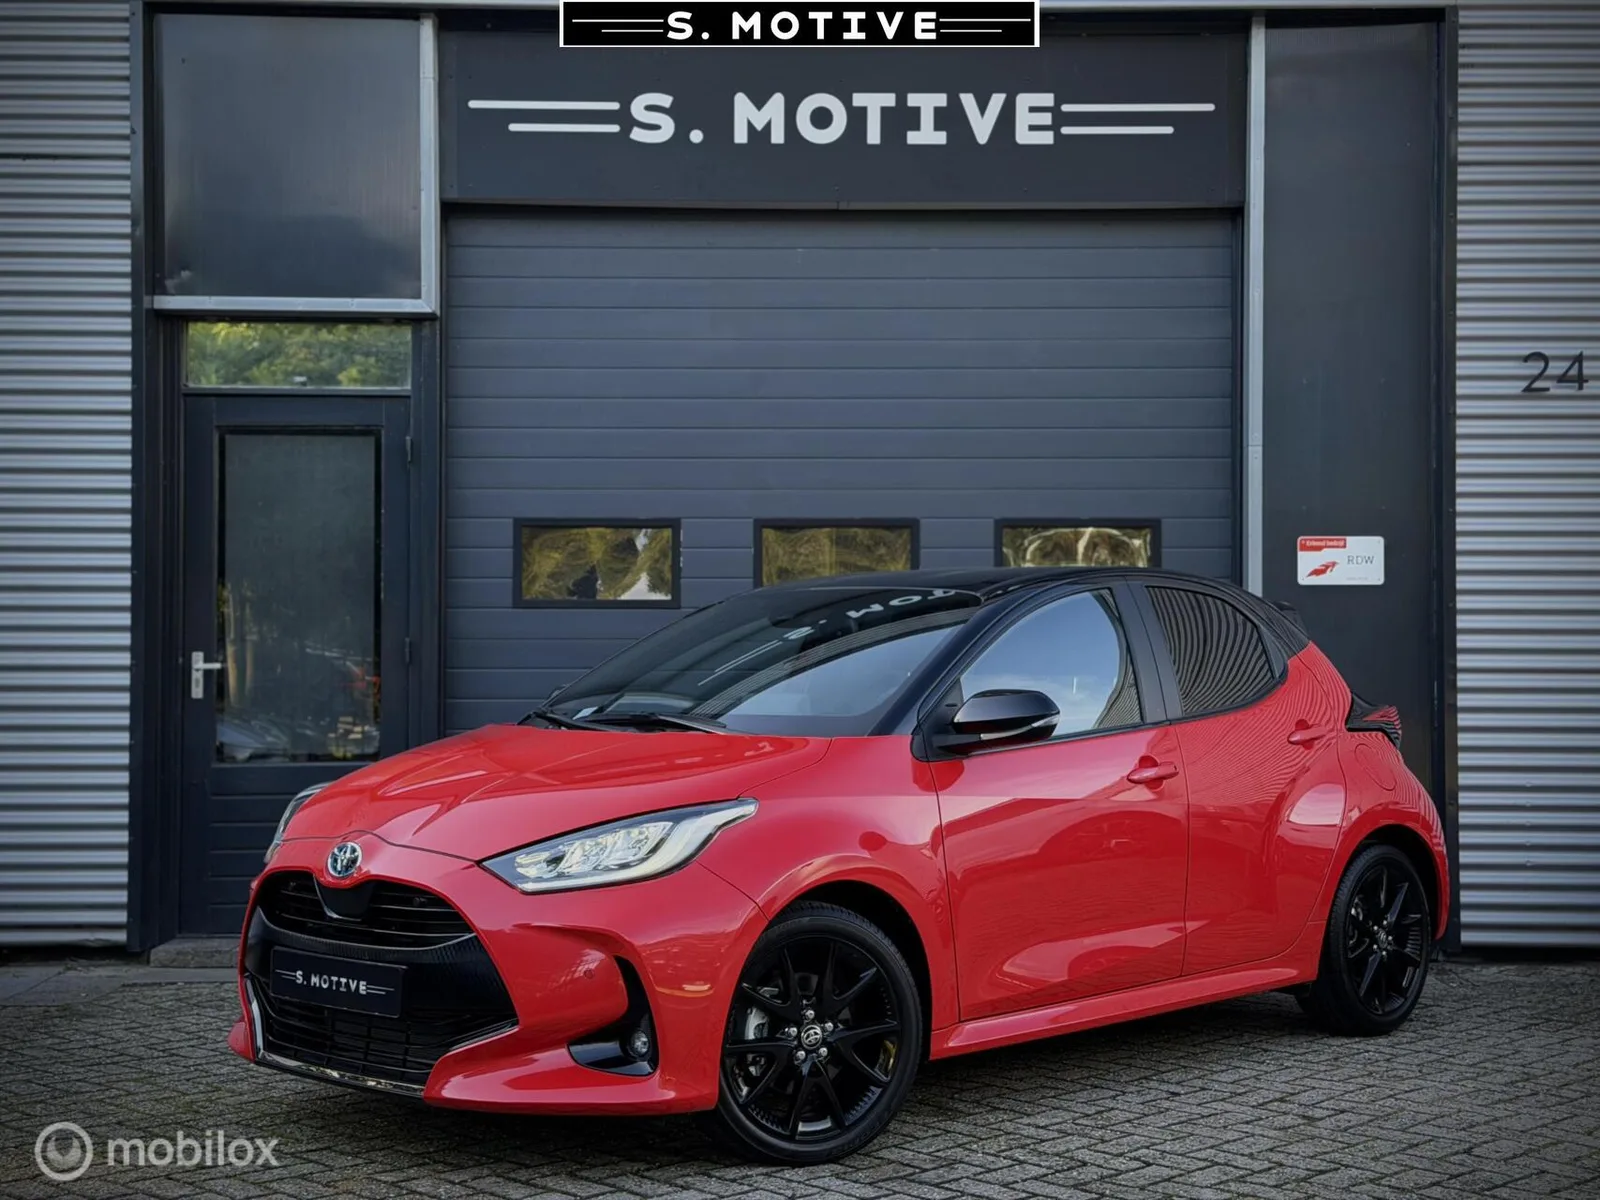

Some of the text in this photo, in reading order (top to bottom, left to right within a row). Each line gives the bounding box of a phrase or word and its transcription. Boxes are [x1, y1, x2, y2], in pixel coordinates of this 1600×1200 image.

[629, 92, 1055, 145] S. MOTIVE
[1521, 350, 1589, 393] 24
[1346, 555, 1375, 565] RDW
[295, 970, 367, 995] S. MOTIVE
